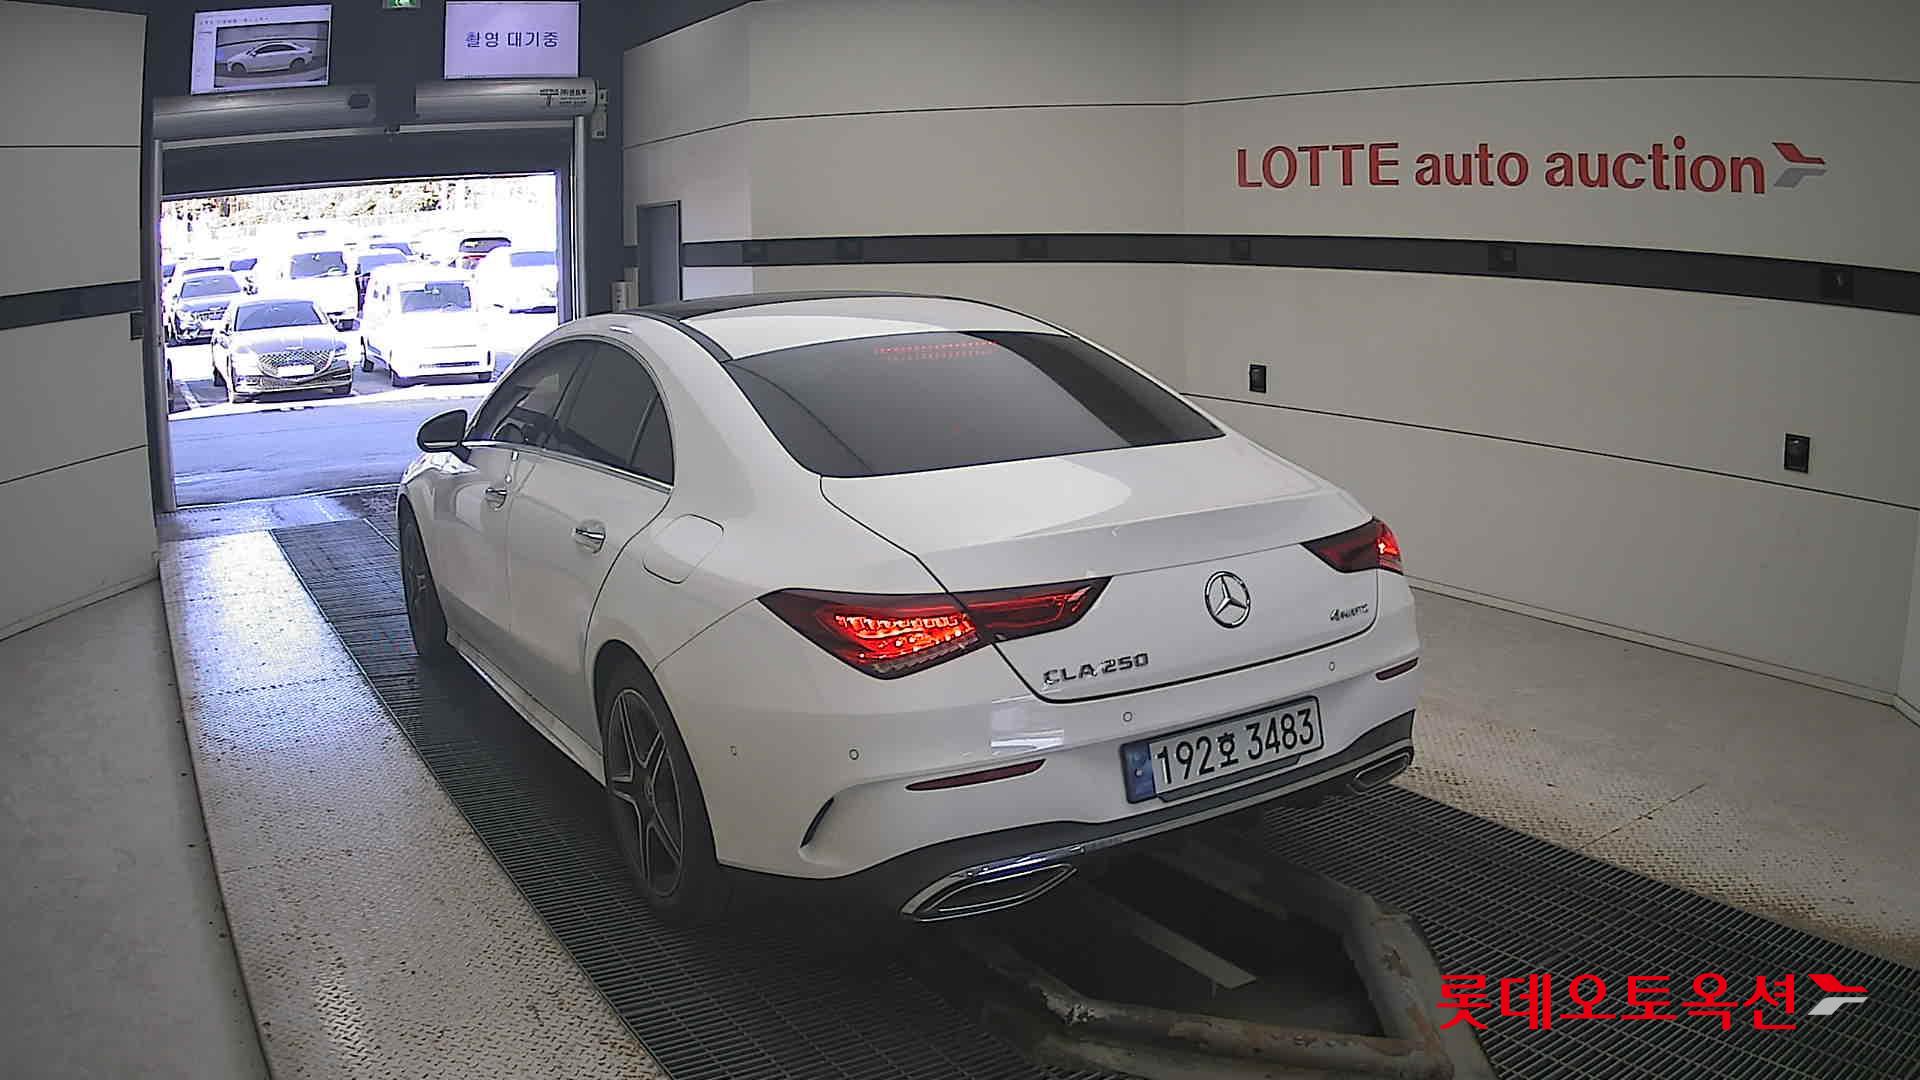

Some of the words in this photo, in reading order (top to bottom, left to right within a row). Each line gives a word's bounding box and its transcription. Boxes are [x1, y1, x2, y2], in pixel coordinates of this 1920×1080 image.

[507, 31, 559, 48] 대기중
[1237, 142, 1399, 189] LOTTE
[1415, 143, 1528, 187] auto
[1545, 136, 1765, 194] auction
[1043, 664, 1097, 685] CLA
[1101, 653, 1149, 674] 250
[1157, 732, 1239, 785] 192호
[1246, 708, 1314, 760] 3483
